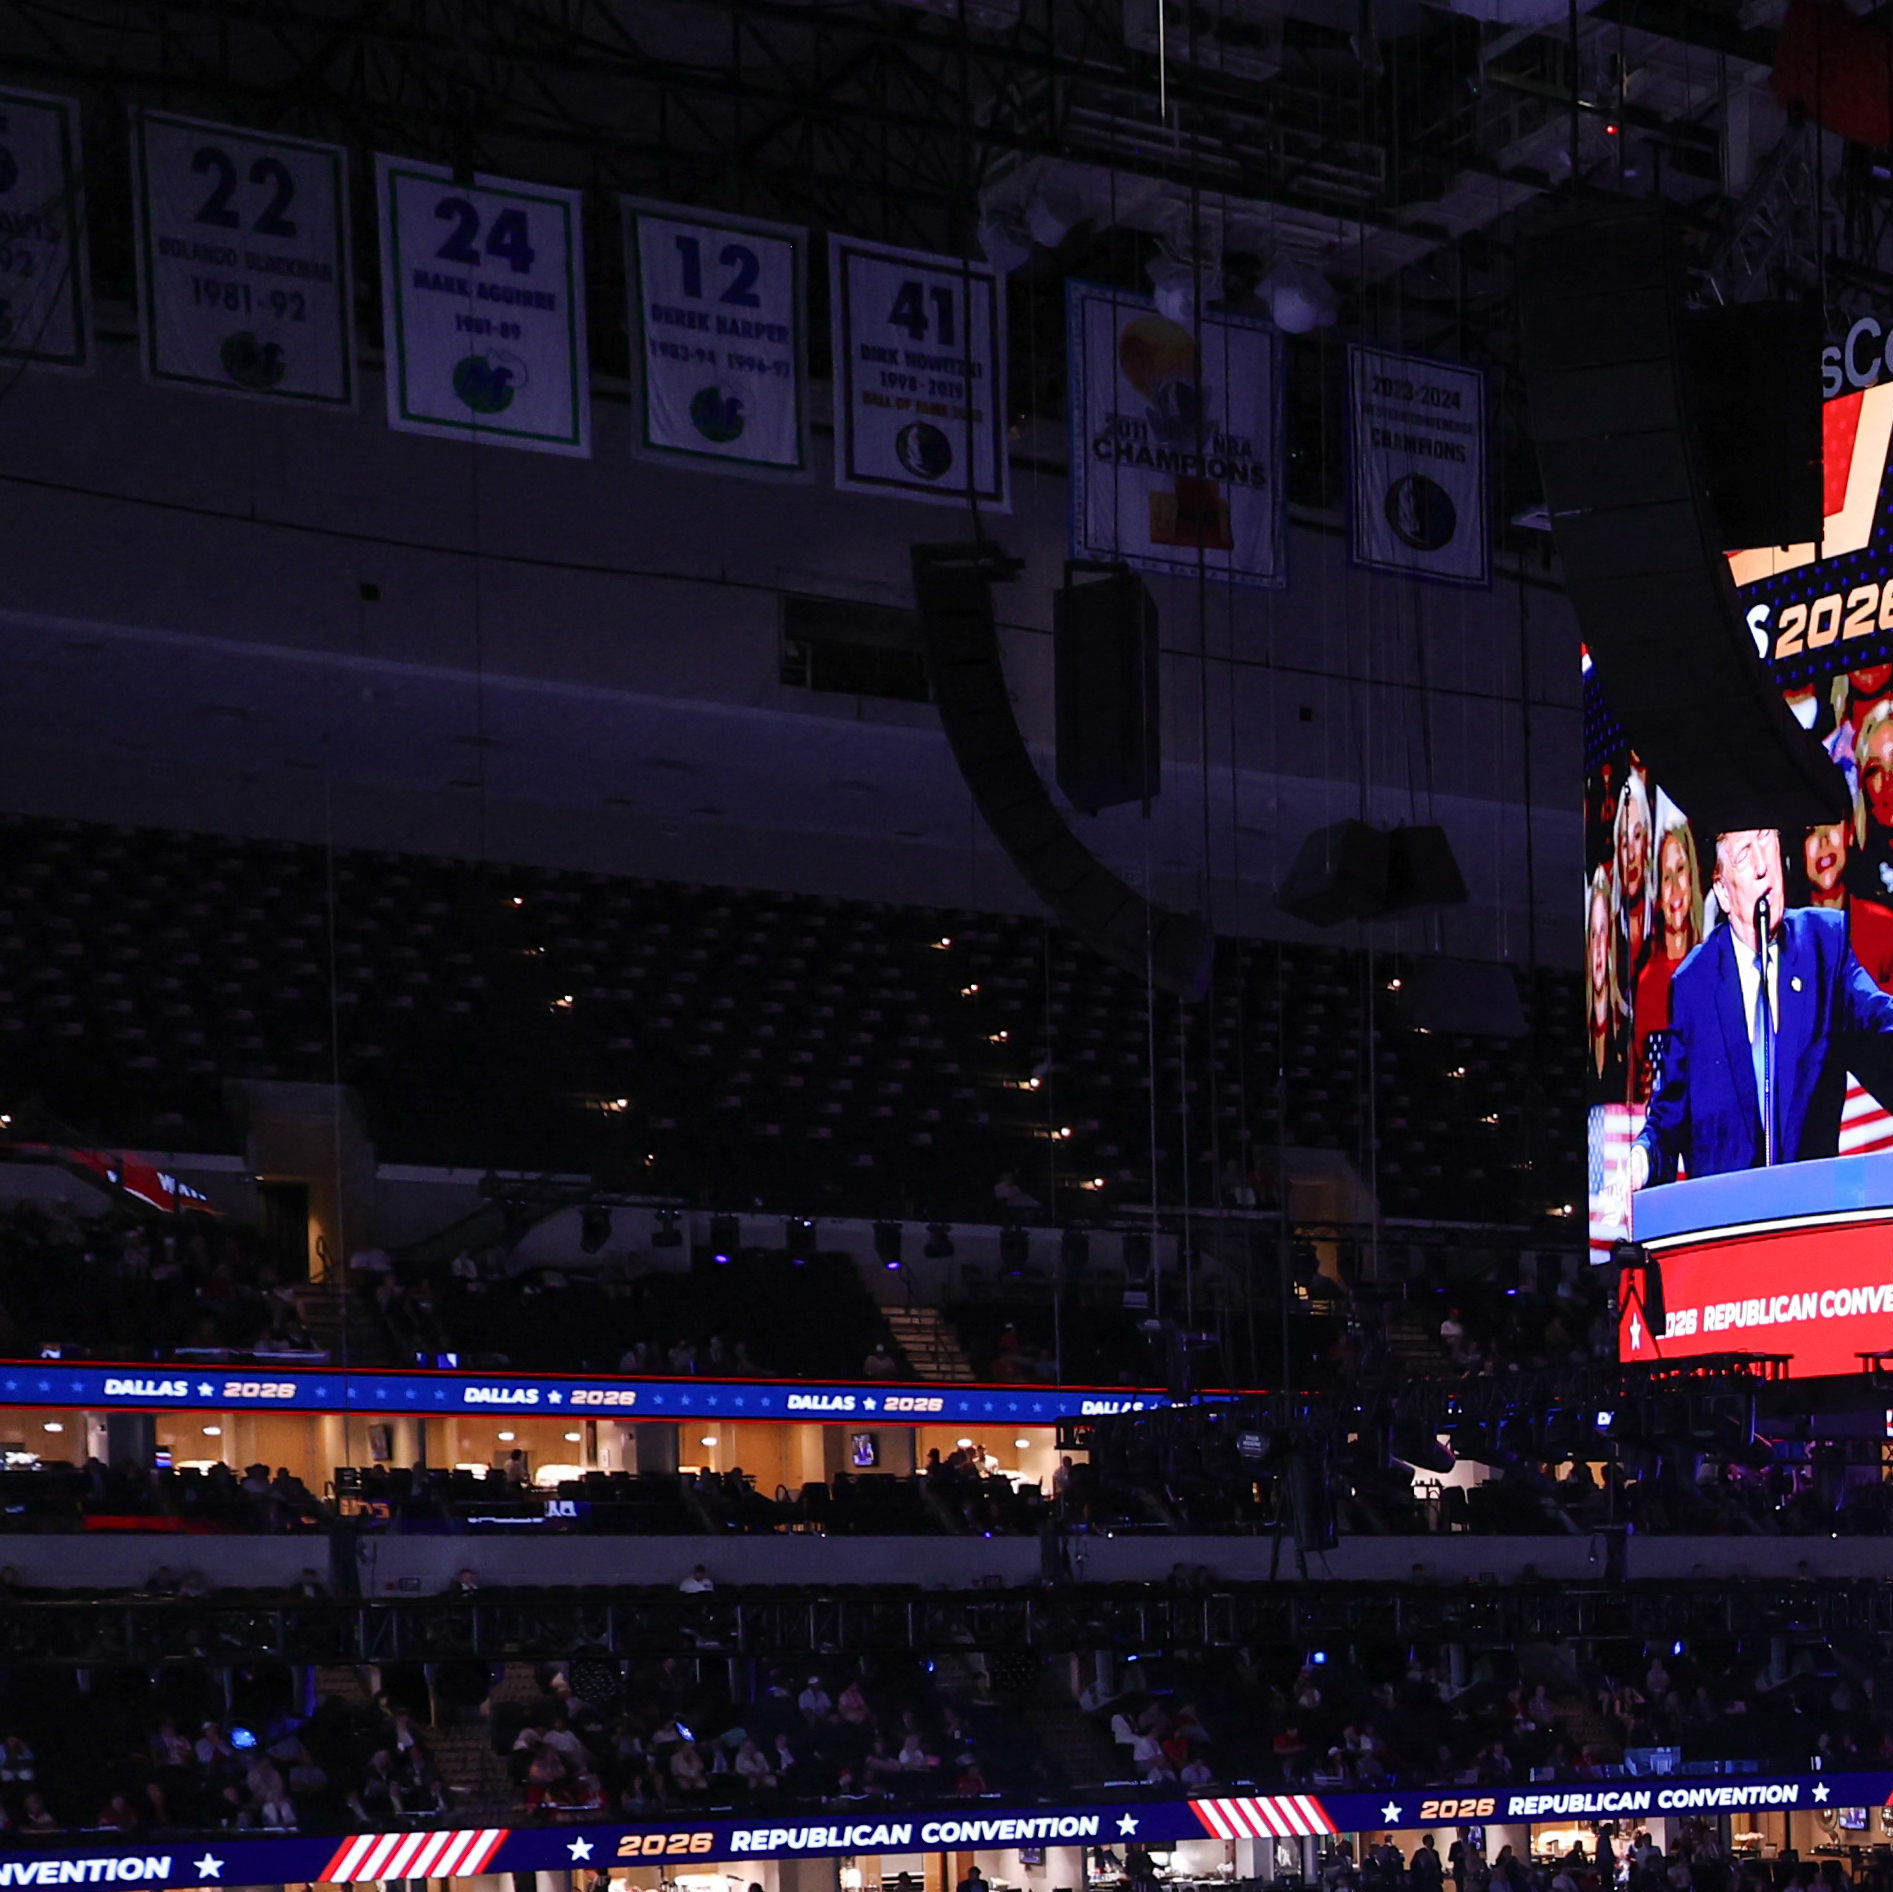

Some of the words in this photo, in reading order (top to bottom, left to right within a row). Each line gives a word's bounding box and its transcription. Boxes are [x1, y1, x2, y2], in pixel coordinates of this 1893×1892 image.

[191, 147, 297, 238] 22
[434, 197, 535, 274] 24
[413, 268, 471, 297] MARK
[478, 282, 556, 311] AGUIRRE
[676, 234, 760, 308] 12
[191, 275, 306, 321] 1981-92
[887, 280, 954, 347] 41
[651, 303, 710, 331] DEREK
[716, 314, 789, 344] HARPER
[860, 343, 900, 366] DIRK
[1104, 414, 1149, 441] 2011
[1213, 433, 1251, 457] NBA
[1371, 427, 1467, 463] CHAMPIONS
[1093, 437, 1266, 487] CHAMPIONS
[1703, 1293, 1818, 1333] REPUBLICAN
[104, 1379, 188, 1397] DALLAS
[222, 1382, 297, 1399] 2026
[463, 1387, 539, 1405] DALLAS
[570, 1390, 636, 1406] 2026
[787, 1395, 856, 1410] DALLAS
[883, 1397, 943, 1412] 2026
[1420, 1797, 1496, 1820] 2026
[1508, 1791, 1651, 1816] REPUBLICAN
[1657, 1784, 1799, 1810] CONVENTION
[617, 1832, 714, 1858] 2026
[730, 1823, 912, 1853] REPUBLICAN
[921, 1815, 1099, 1845] CONVENTION
